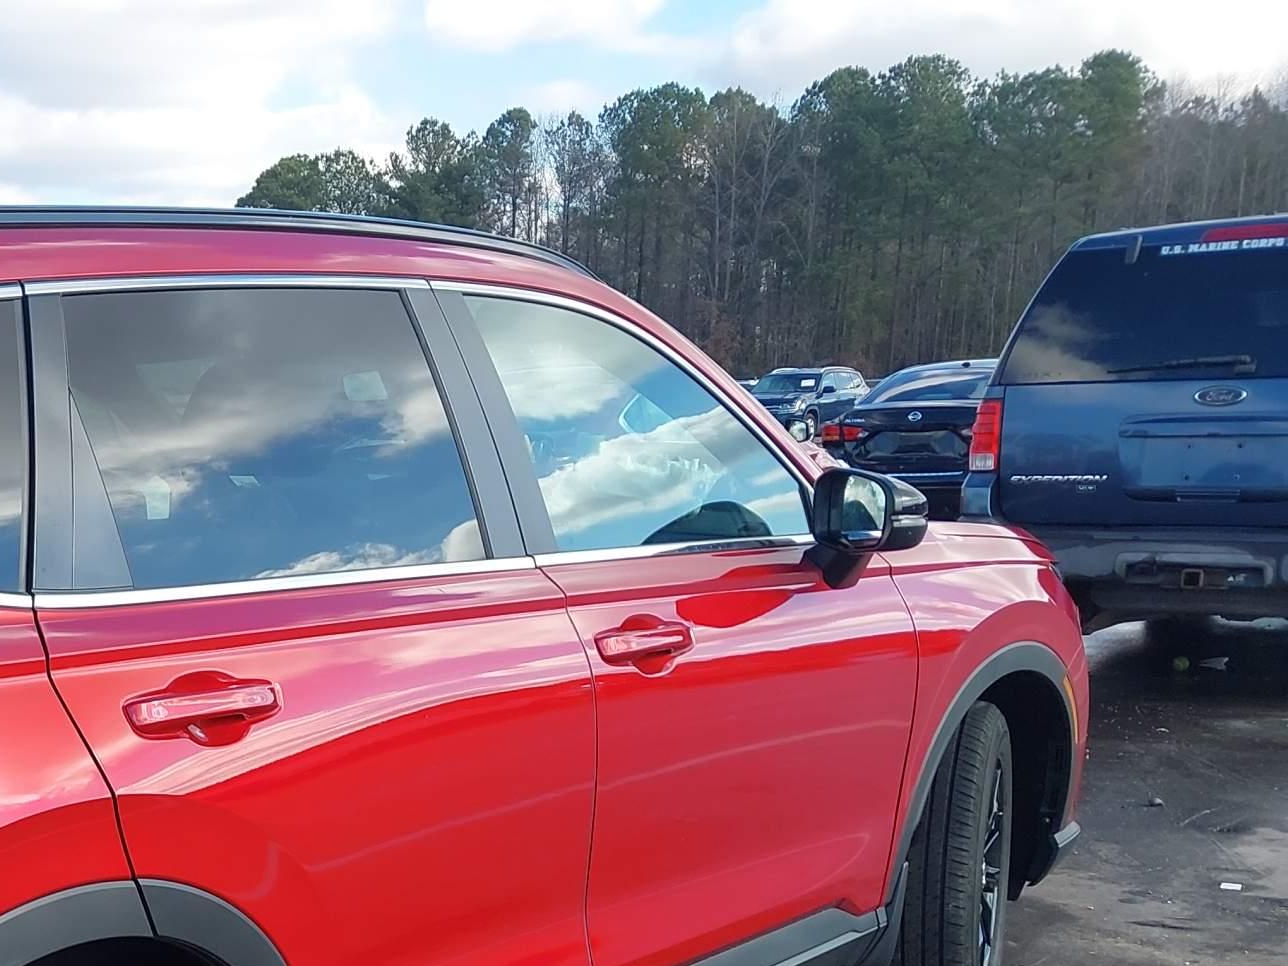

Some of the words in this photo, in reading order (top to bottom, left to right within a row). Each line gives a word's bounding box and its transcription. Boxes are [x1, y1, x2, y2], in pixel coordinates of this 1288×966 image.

[1161, 245, 1185, 255] U.S.
[1188, 241, 1239, 253] MARINE
[1242, 237, 1285, 249] CORPS
